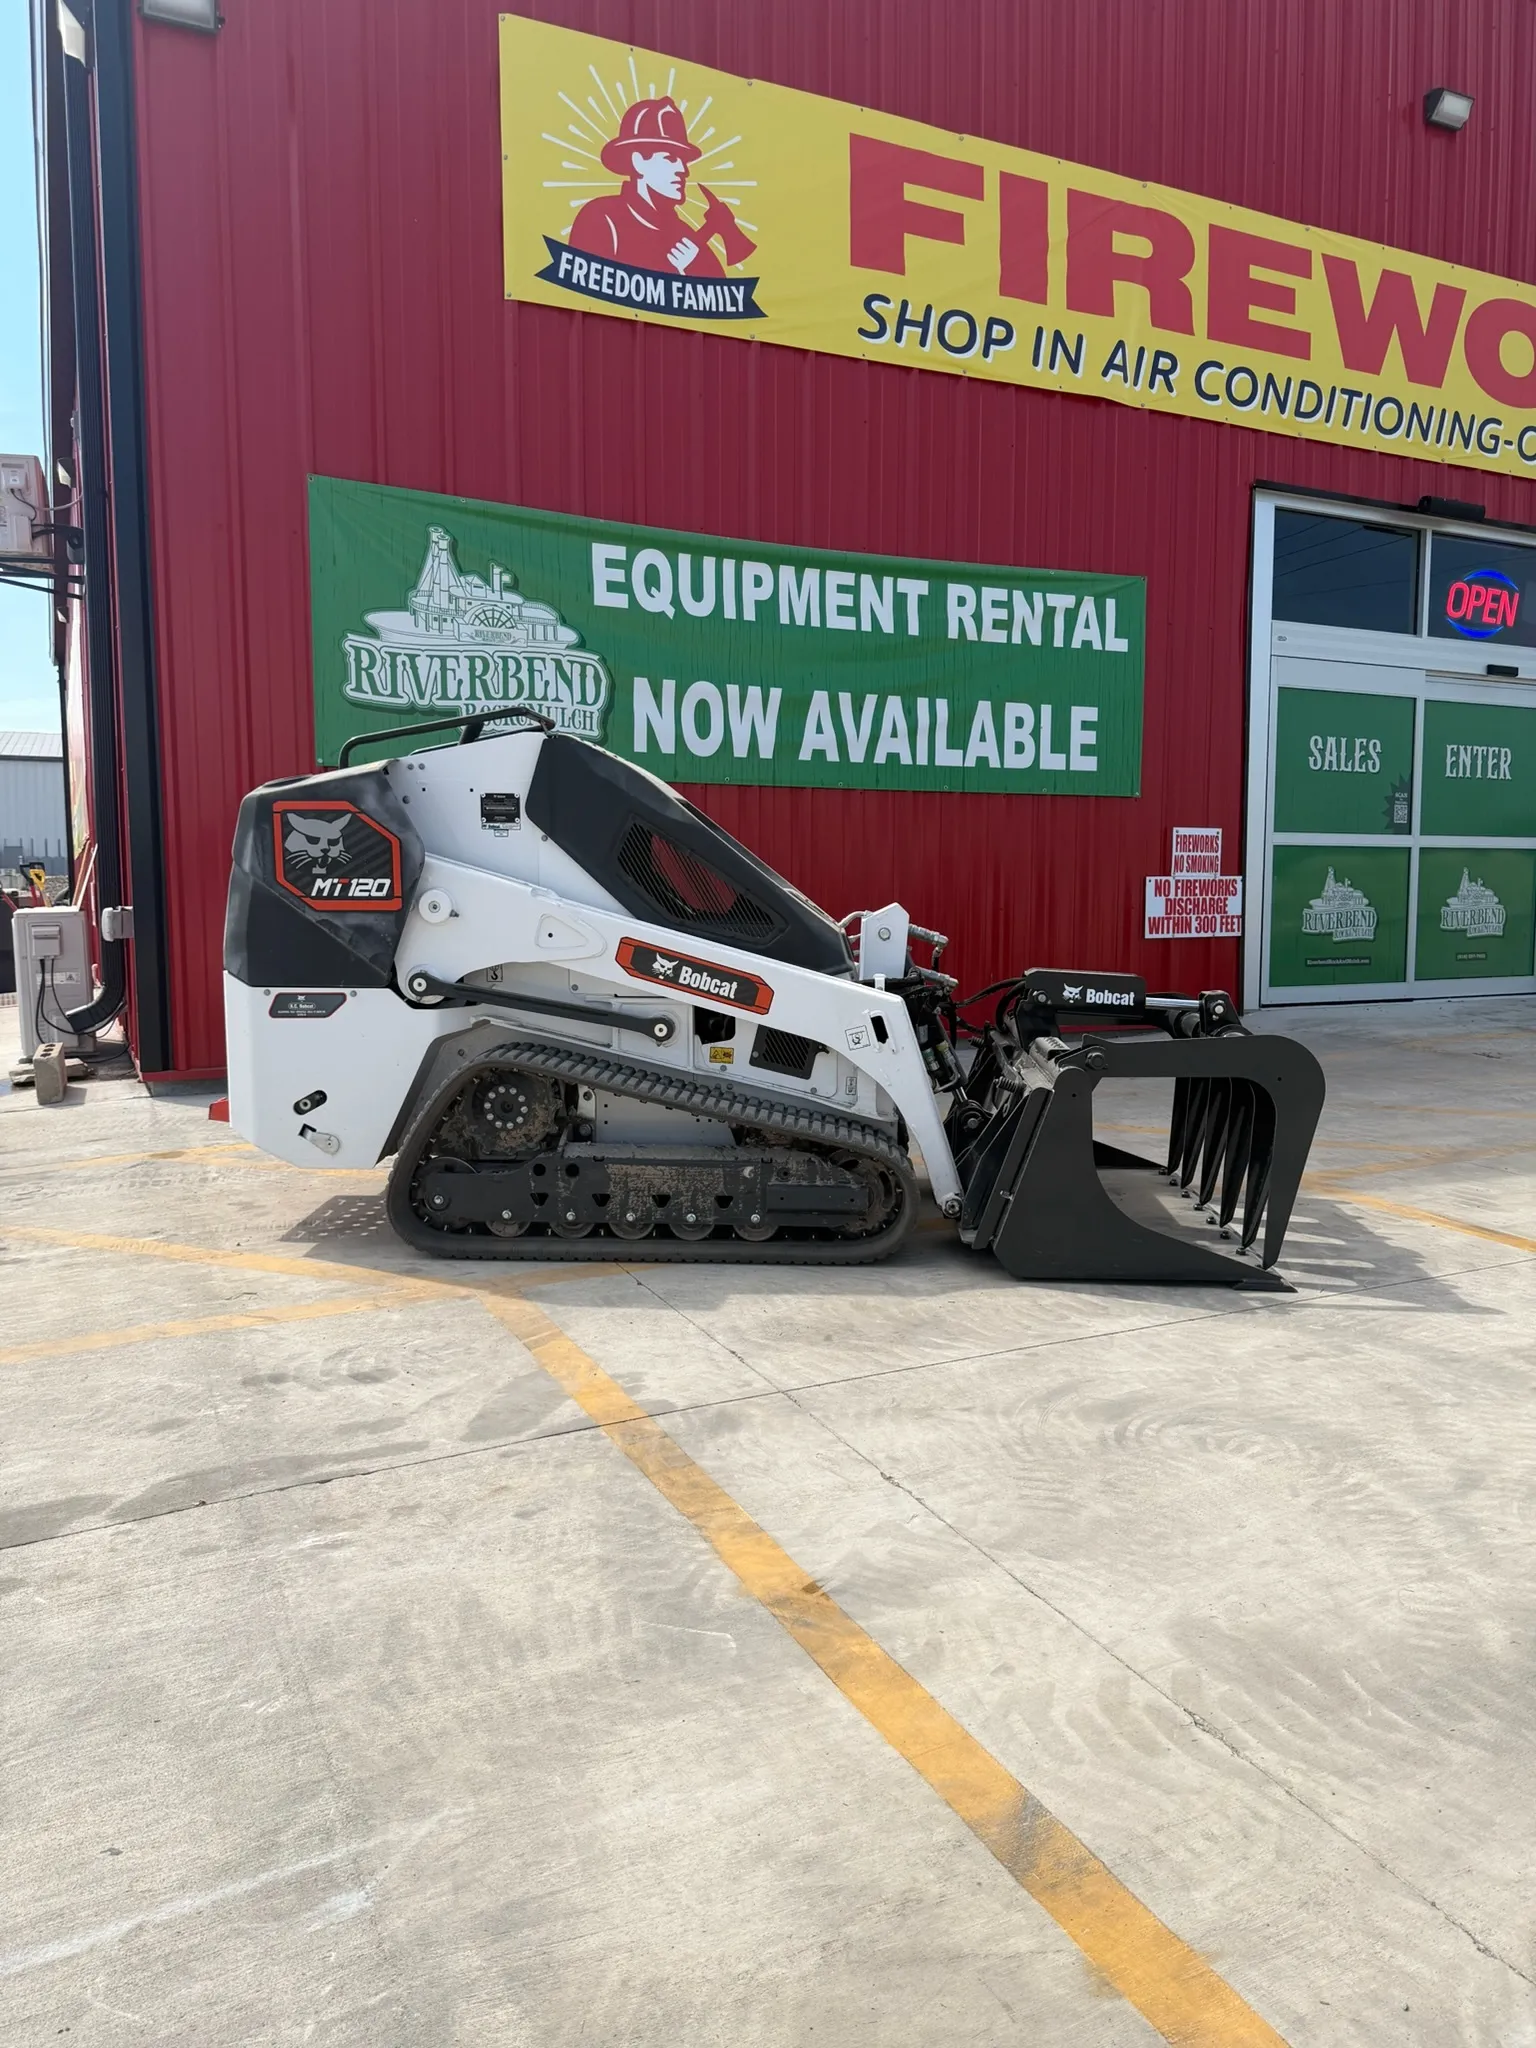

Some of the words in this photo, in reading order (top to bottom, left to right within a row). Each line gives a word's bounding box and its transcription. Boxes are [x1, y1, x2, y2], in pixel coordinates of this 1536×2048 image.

[558, 251, 665, 306] FREEDOM
[671, 281, 745, 312] FAMILY
[850, 132, 1536, 410] FIREWO
[858, 293, 1015, 362] SHOP
[1032, 325, 1085, 376] IN
[1101, 339, 1179, 395] AIR
[591, 542, 928, 636] EQUIPMENT
[947, 583, 1128, 652] RENTAL
[1446, 581, 1519, 628] OPEN
[349, 644, 604, 706] RIVERBEND
[633, 677, 782, 759] NOW
[798, 690, 1098, 771] AVAILABLE
[1308, 735, 1382, 773] SALES
[1445, 744, 1512, 780] ENTER
[1175, 834, 1220, 853] FIREWORKS
[1173, 854, 1184, 873] NO
[1186, 854, 1219, 873] SMOKING
[1154, 879, 1171, 897] NO
[1174, 879, 1238, 897] FIREWORKS
[1165, 897, 1229, 915] DISCHARGE
[1303, 910, 1376, 931] RIVERBEND
[1441, 907, 1505, 927] RIVERBEND
[1148, 916, 1192, 934] WITHIN
[1195, 916, 1217, 933] 300
[1220, 915, 1242, 932] FEET
[678, 966, 738, 999] Bobcat
[1085, 988, 1135, 1006] Bobcat
